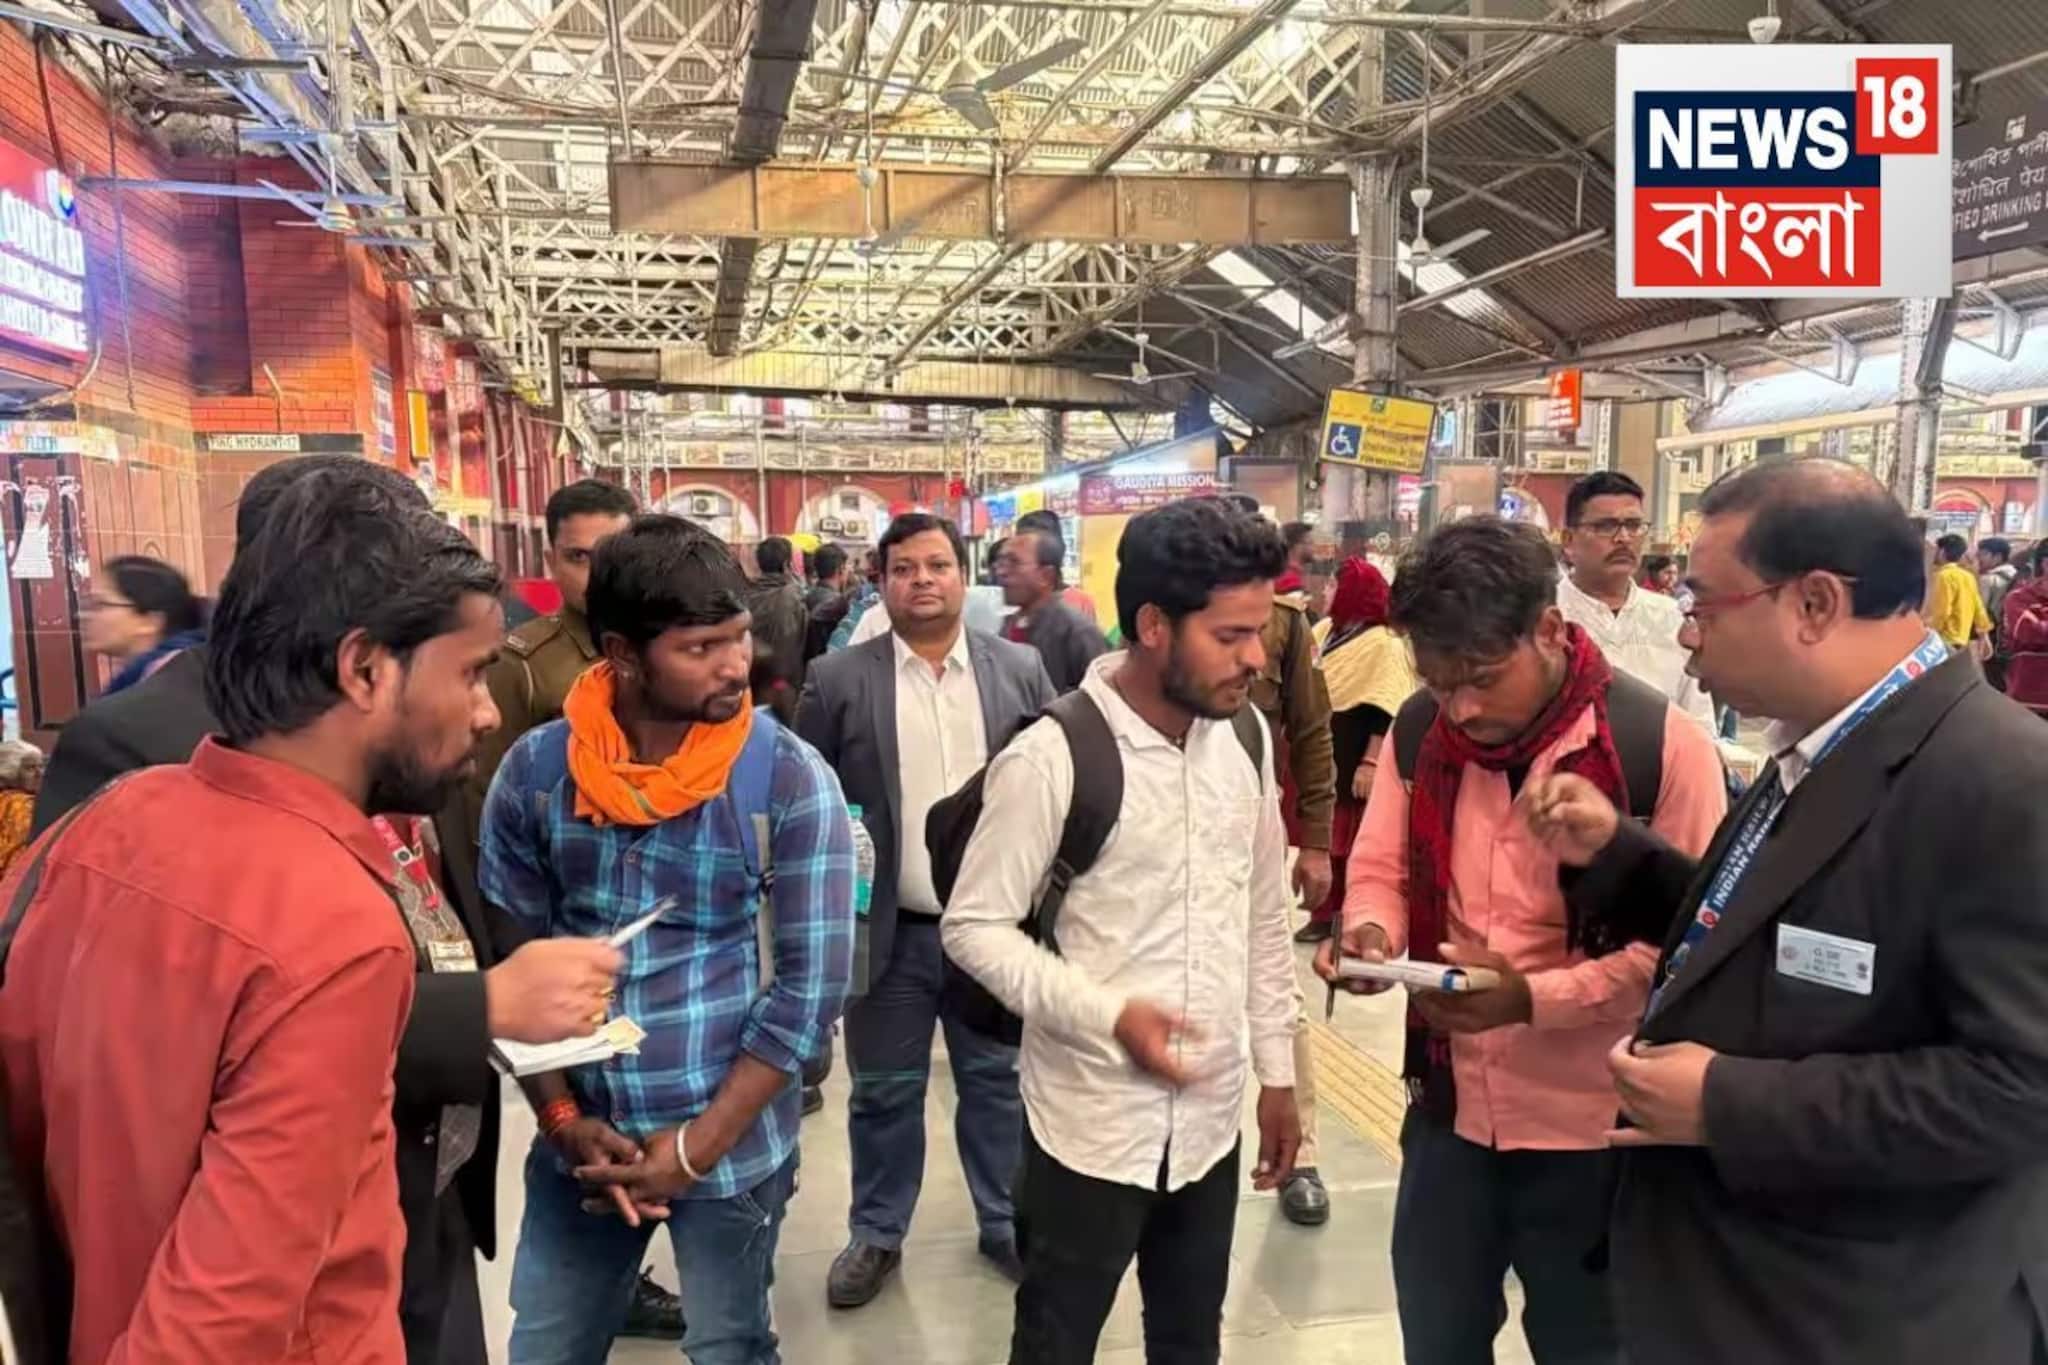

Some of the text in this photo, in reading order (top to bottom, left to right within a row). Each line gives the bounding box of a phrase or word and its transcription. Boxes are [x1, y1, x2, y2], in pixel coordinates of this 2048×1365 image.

[1952, 207, 1980, 232] FIED
[1981, 190, 2042, 225] DRINKING
[1167, 473, 1216, 487] MISSION
[1713, 853, 1750, 908] INDIAN
